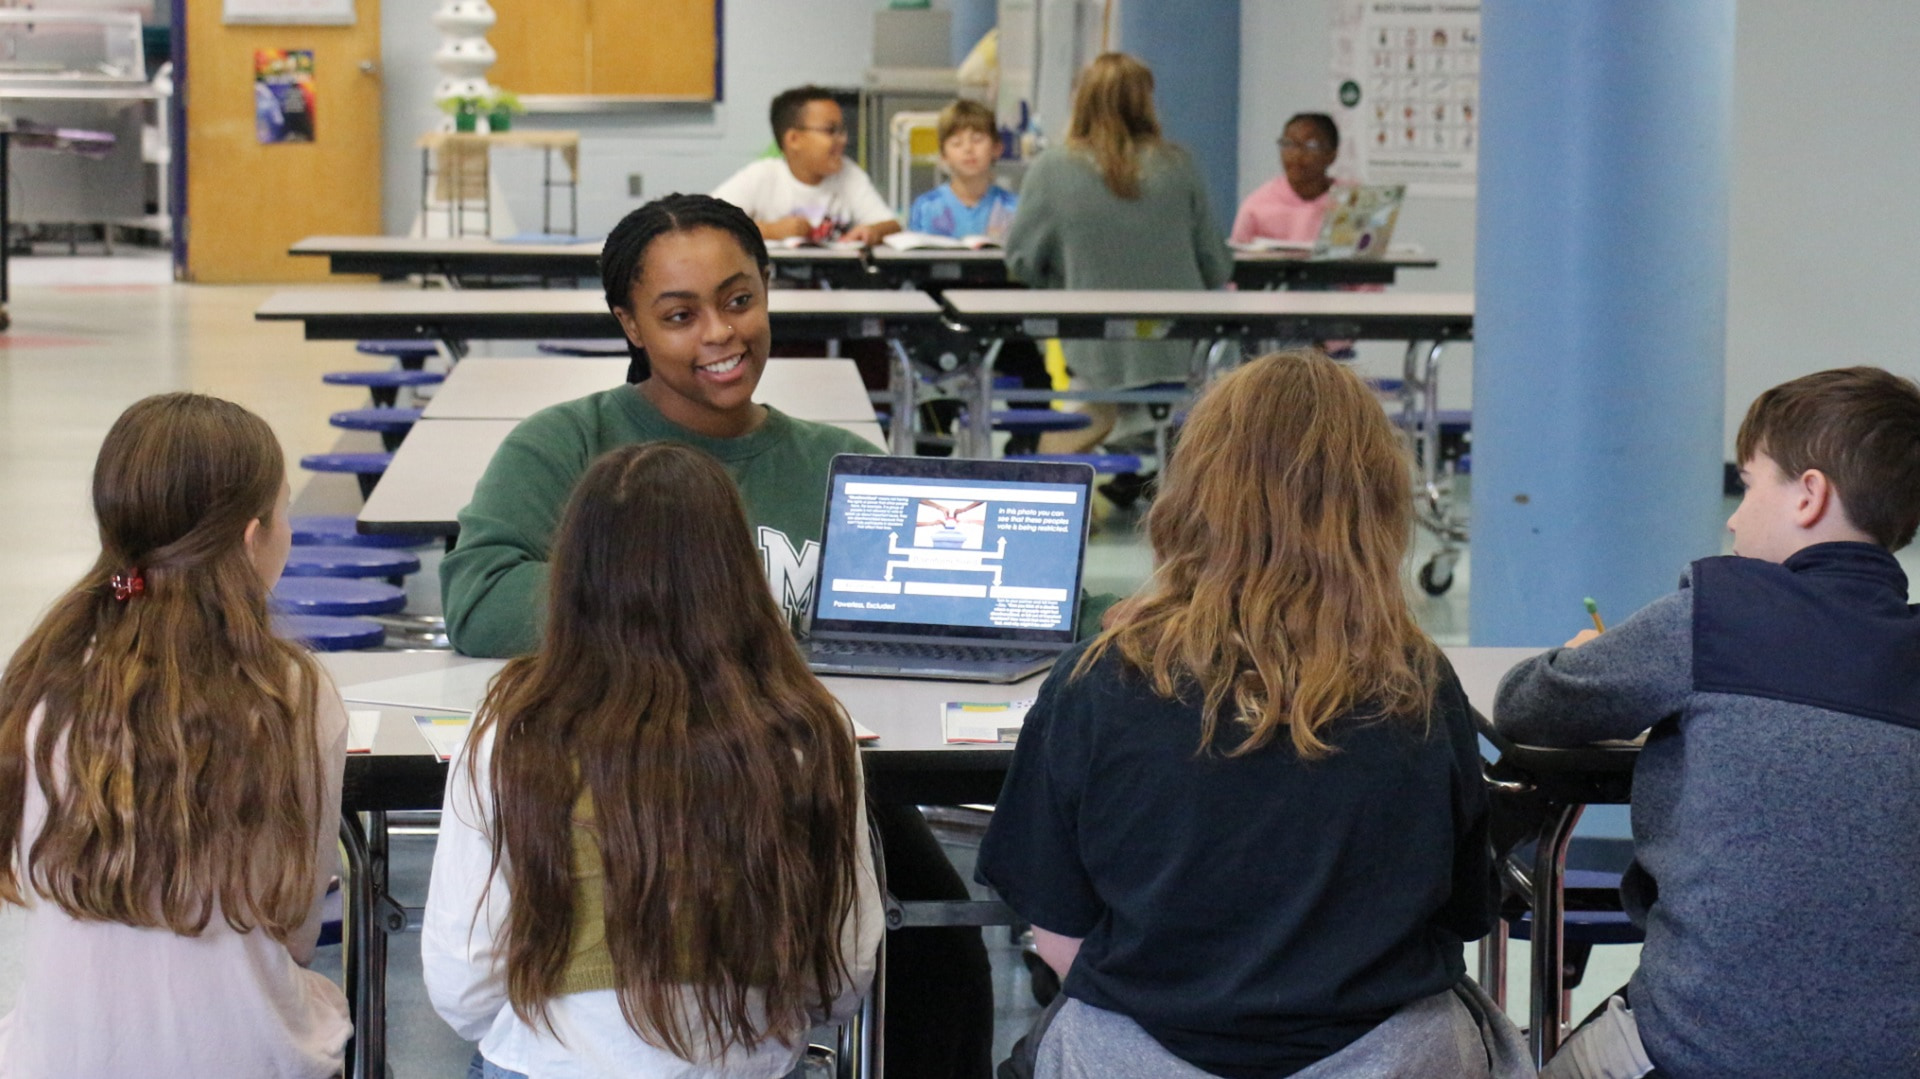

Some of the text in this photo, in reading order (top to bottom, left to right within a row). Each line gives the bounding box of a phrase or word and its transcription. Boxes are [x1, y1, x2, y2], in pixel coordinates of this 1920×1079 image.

[1006, 507, 1016, 515] this
[1017, 508, 1037, 516] photo
[1018, 524, 1037, 532] being
[866, 601, 896, 610] Excluded
